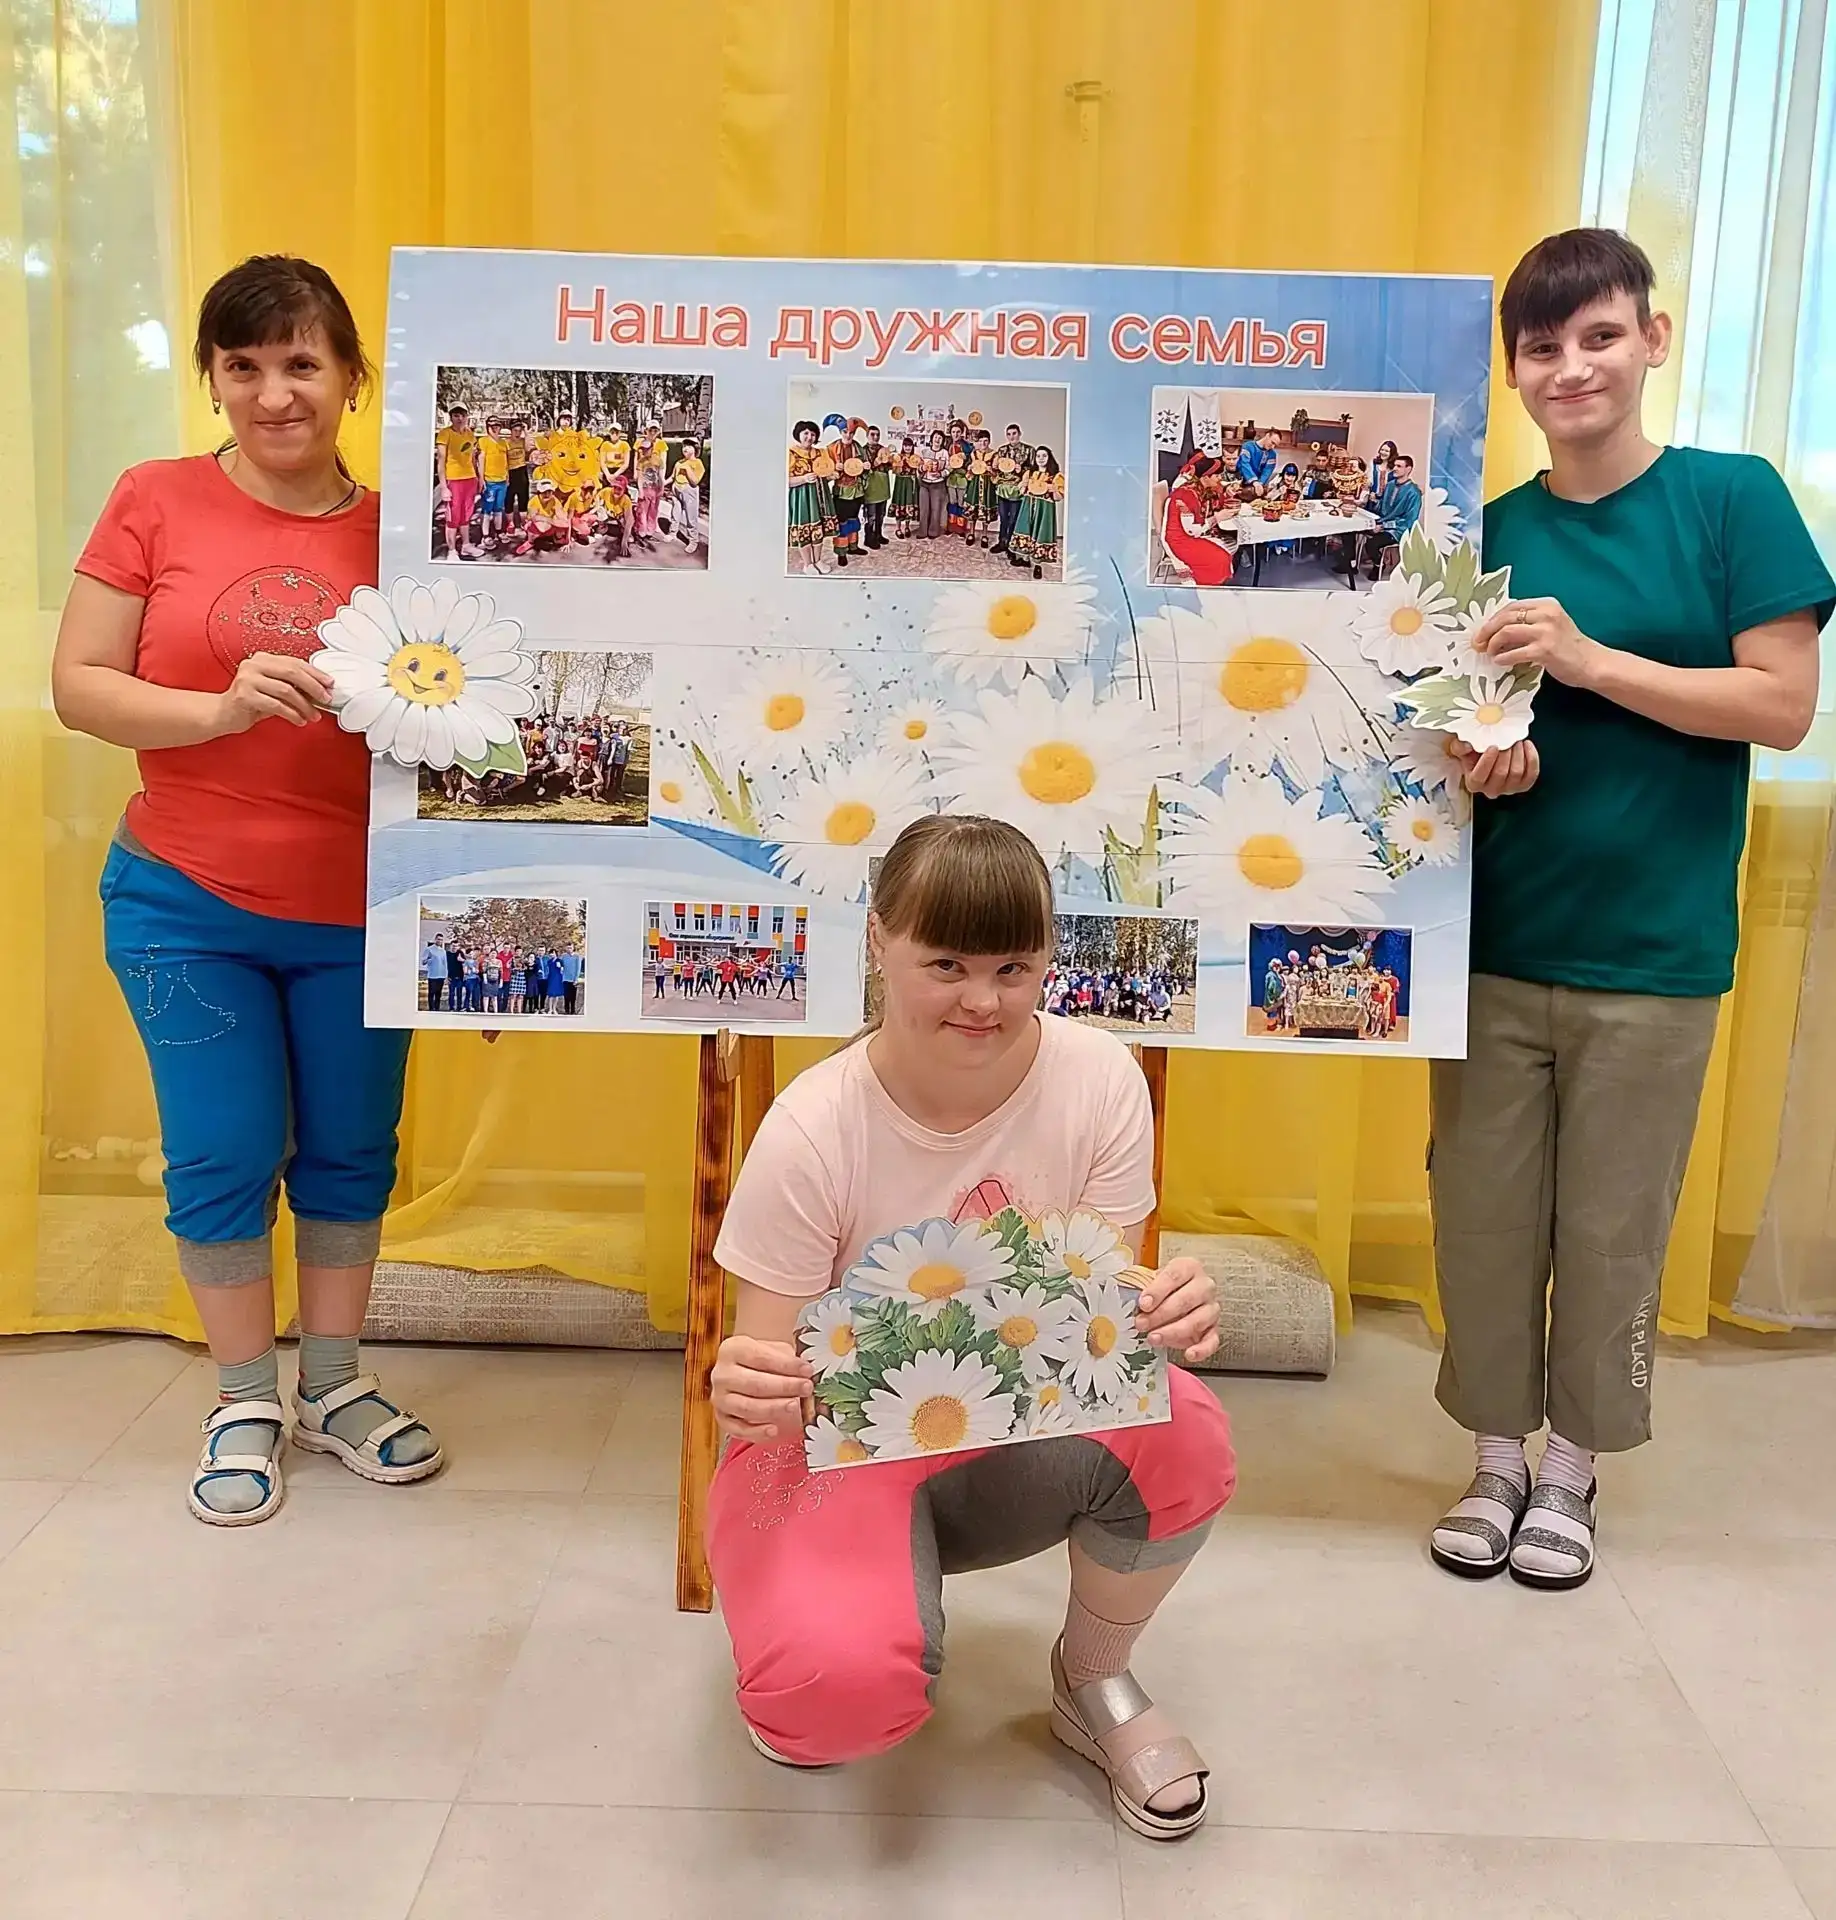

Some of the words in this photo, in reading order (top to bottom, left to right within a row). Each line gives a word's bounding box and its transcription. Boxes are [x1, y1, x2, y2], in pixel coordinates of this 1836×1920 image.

[557, 285, 749, 348] Наша
[768, 306, 1089, 367] дружная
[1109, 312, 1328, 369] семья
[1631, 1330, 1648, 1388] PLACID
